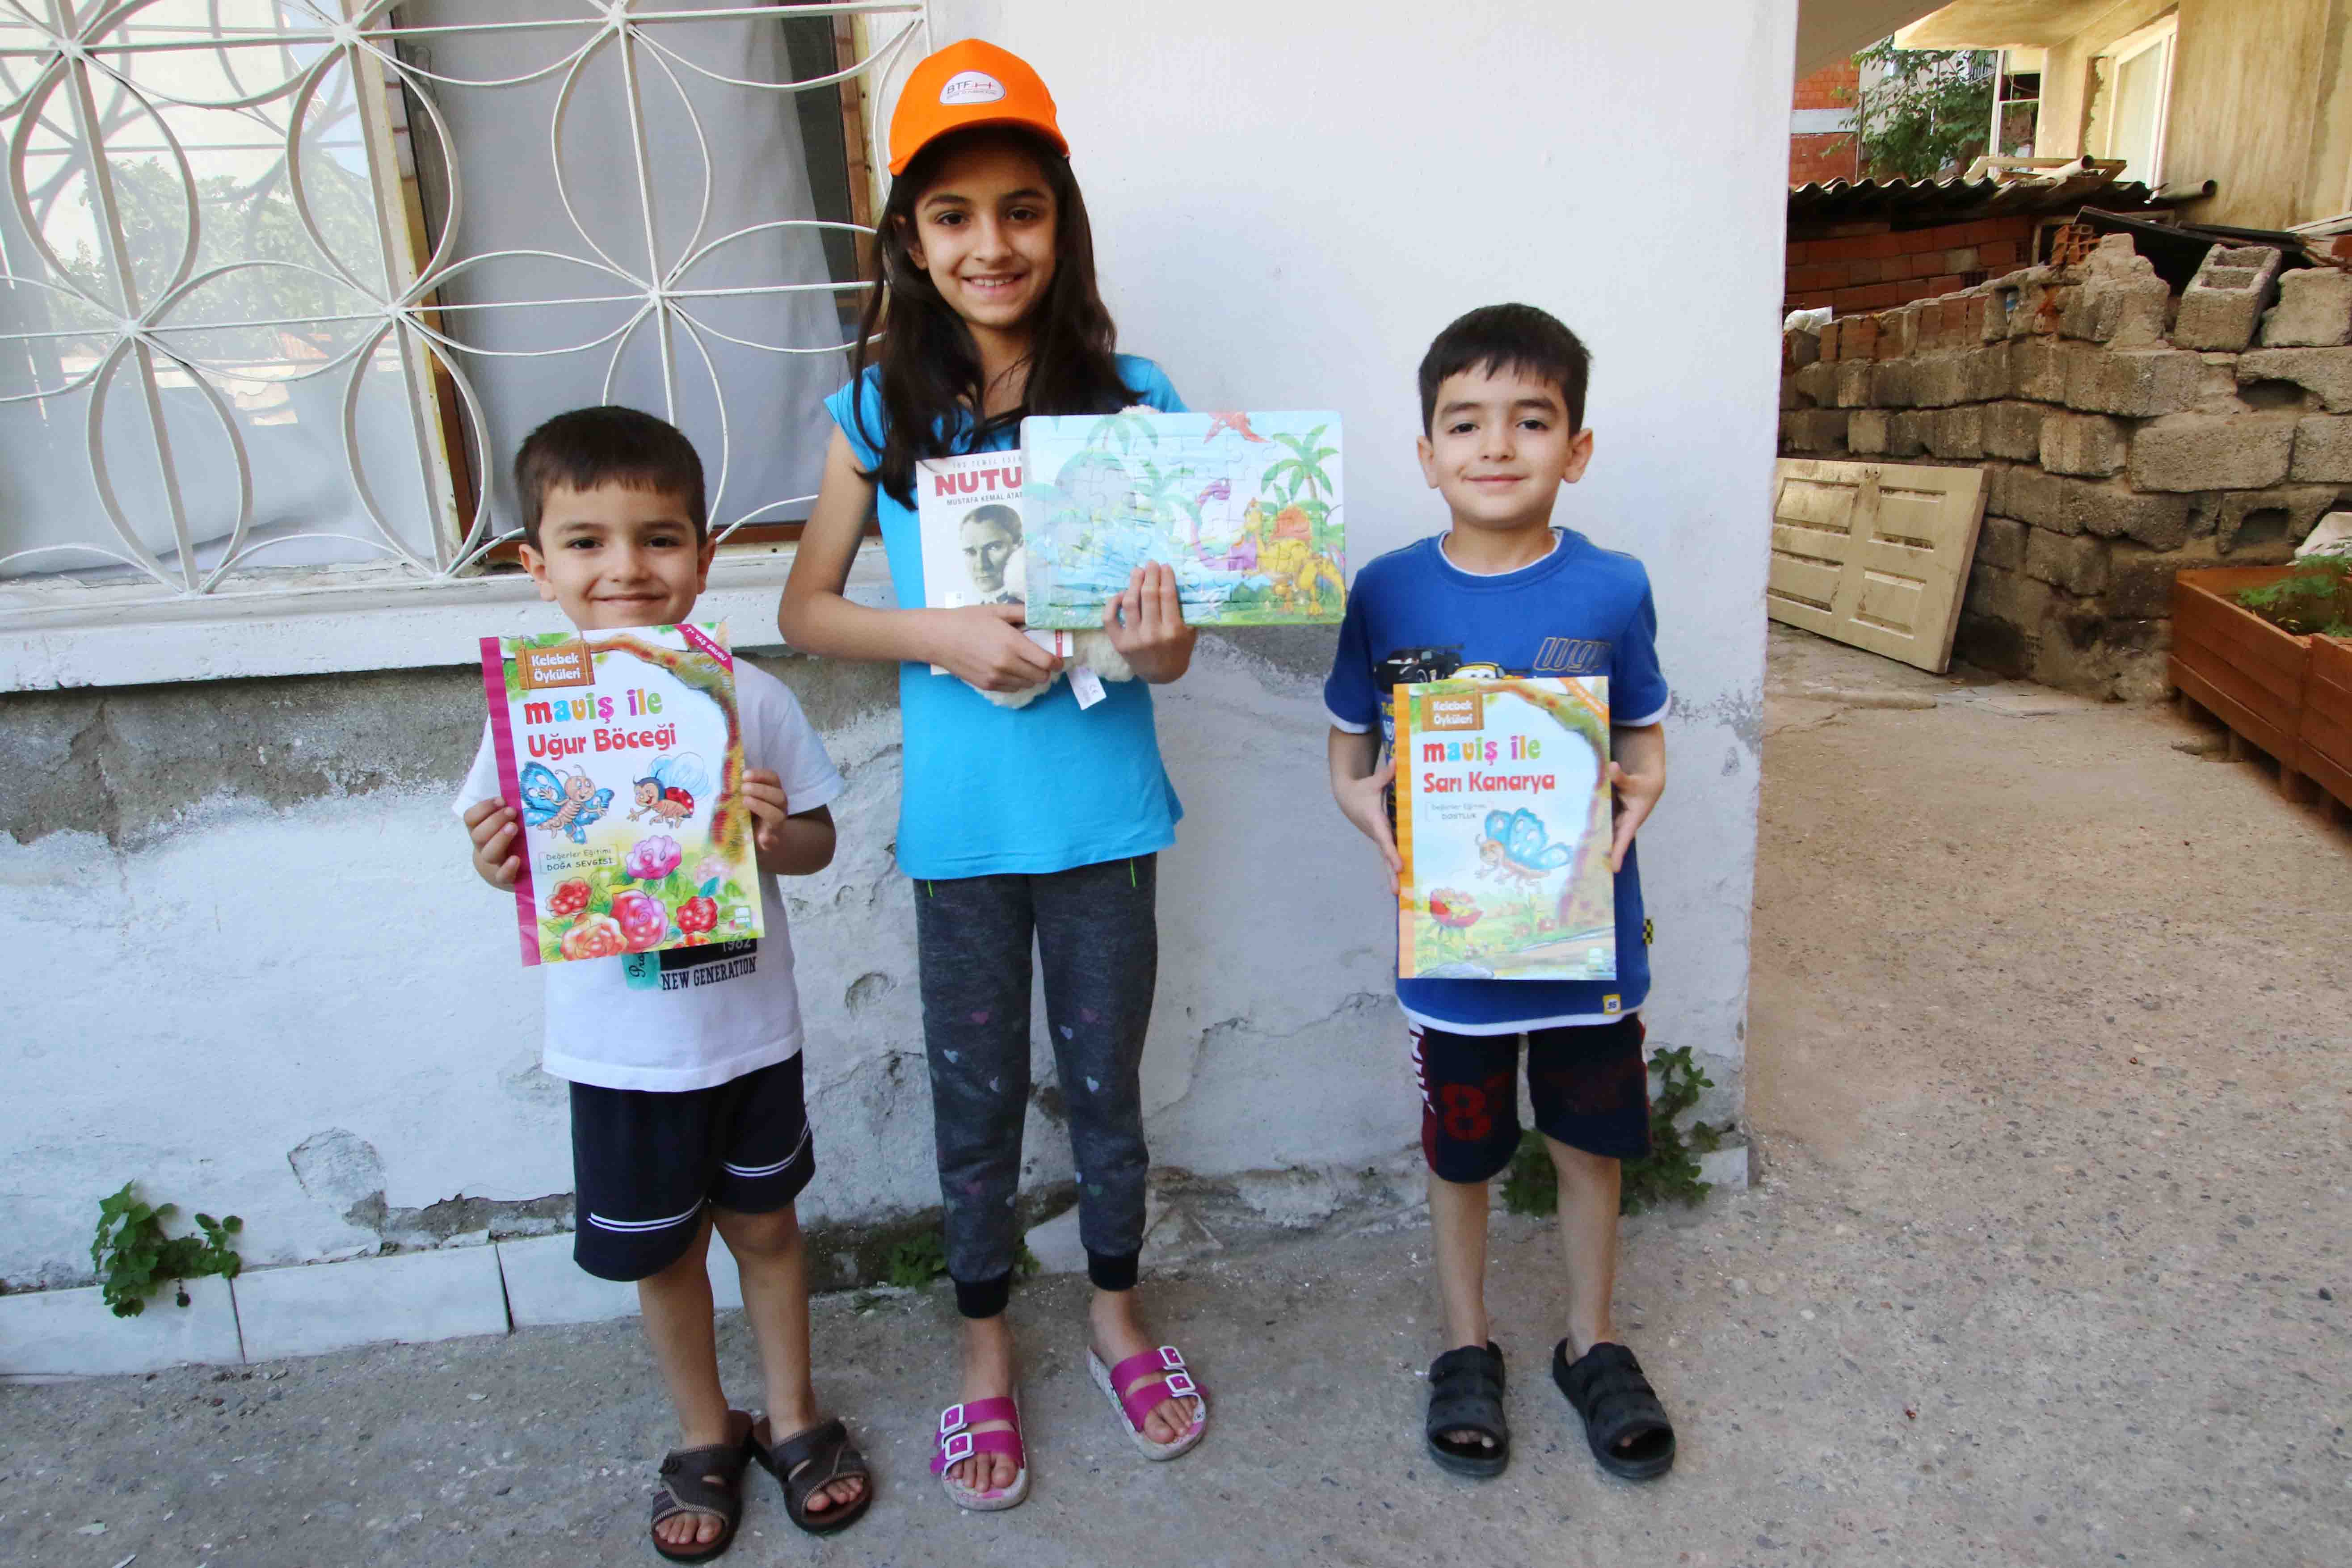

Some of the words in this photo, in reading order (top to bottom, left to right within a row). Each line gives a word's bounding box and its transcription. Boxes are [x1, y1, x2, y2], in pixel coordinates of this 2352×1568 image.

[947, 497, 978, 505] MUSTAFA
[981, 494, 1004, 502] KEMAL
[531, 652, 579, 666] Kelebek
[534, 667, 581, 683] Öyküleri
[627, 688, 663, 716] ile
[1433, 700, 1473, 711] Kelebek
[528, 733, 586, 761] Uğur
[593, 723, 676, 752] Böceği
[1510, 735, 1541, 760] ile
[1423, 773, 1462, 793] Sarı
[1468, 771, 1556, 794] Kanarya
[546, 852, 580, 861] Değerler
[547, 862, 572, 871] DOĞA
[661, 971, 690, 991] NEW
[694, 956, 757, 987] GENERATION
